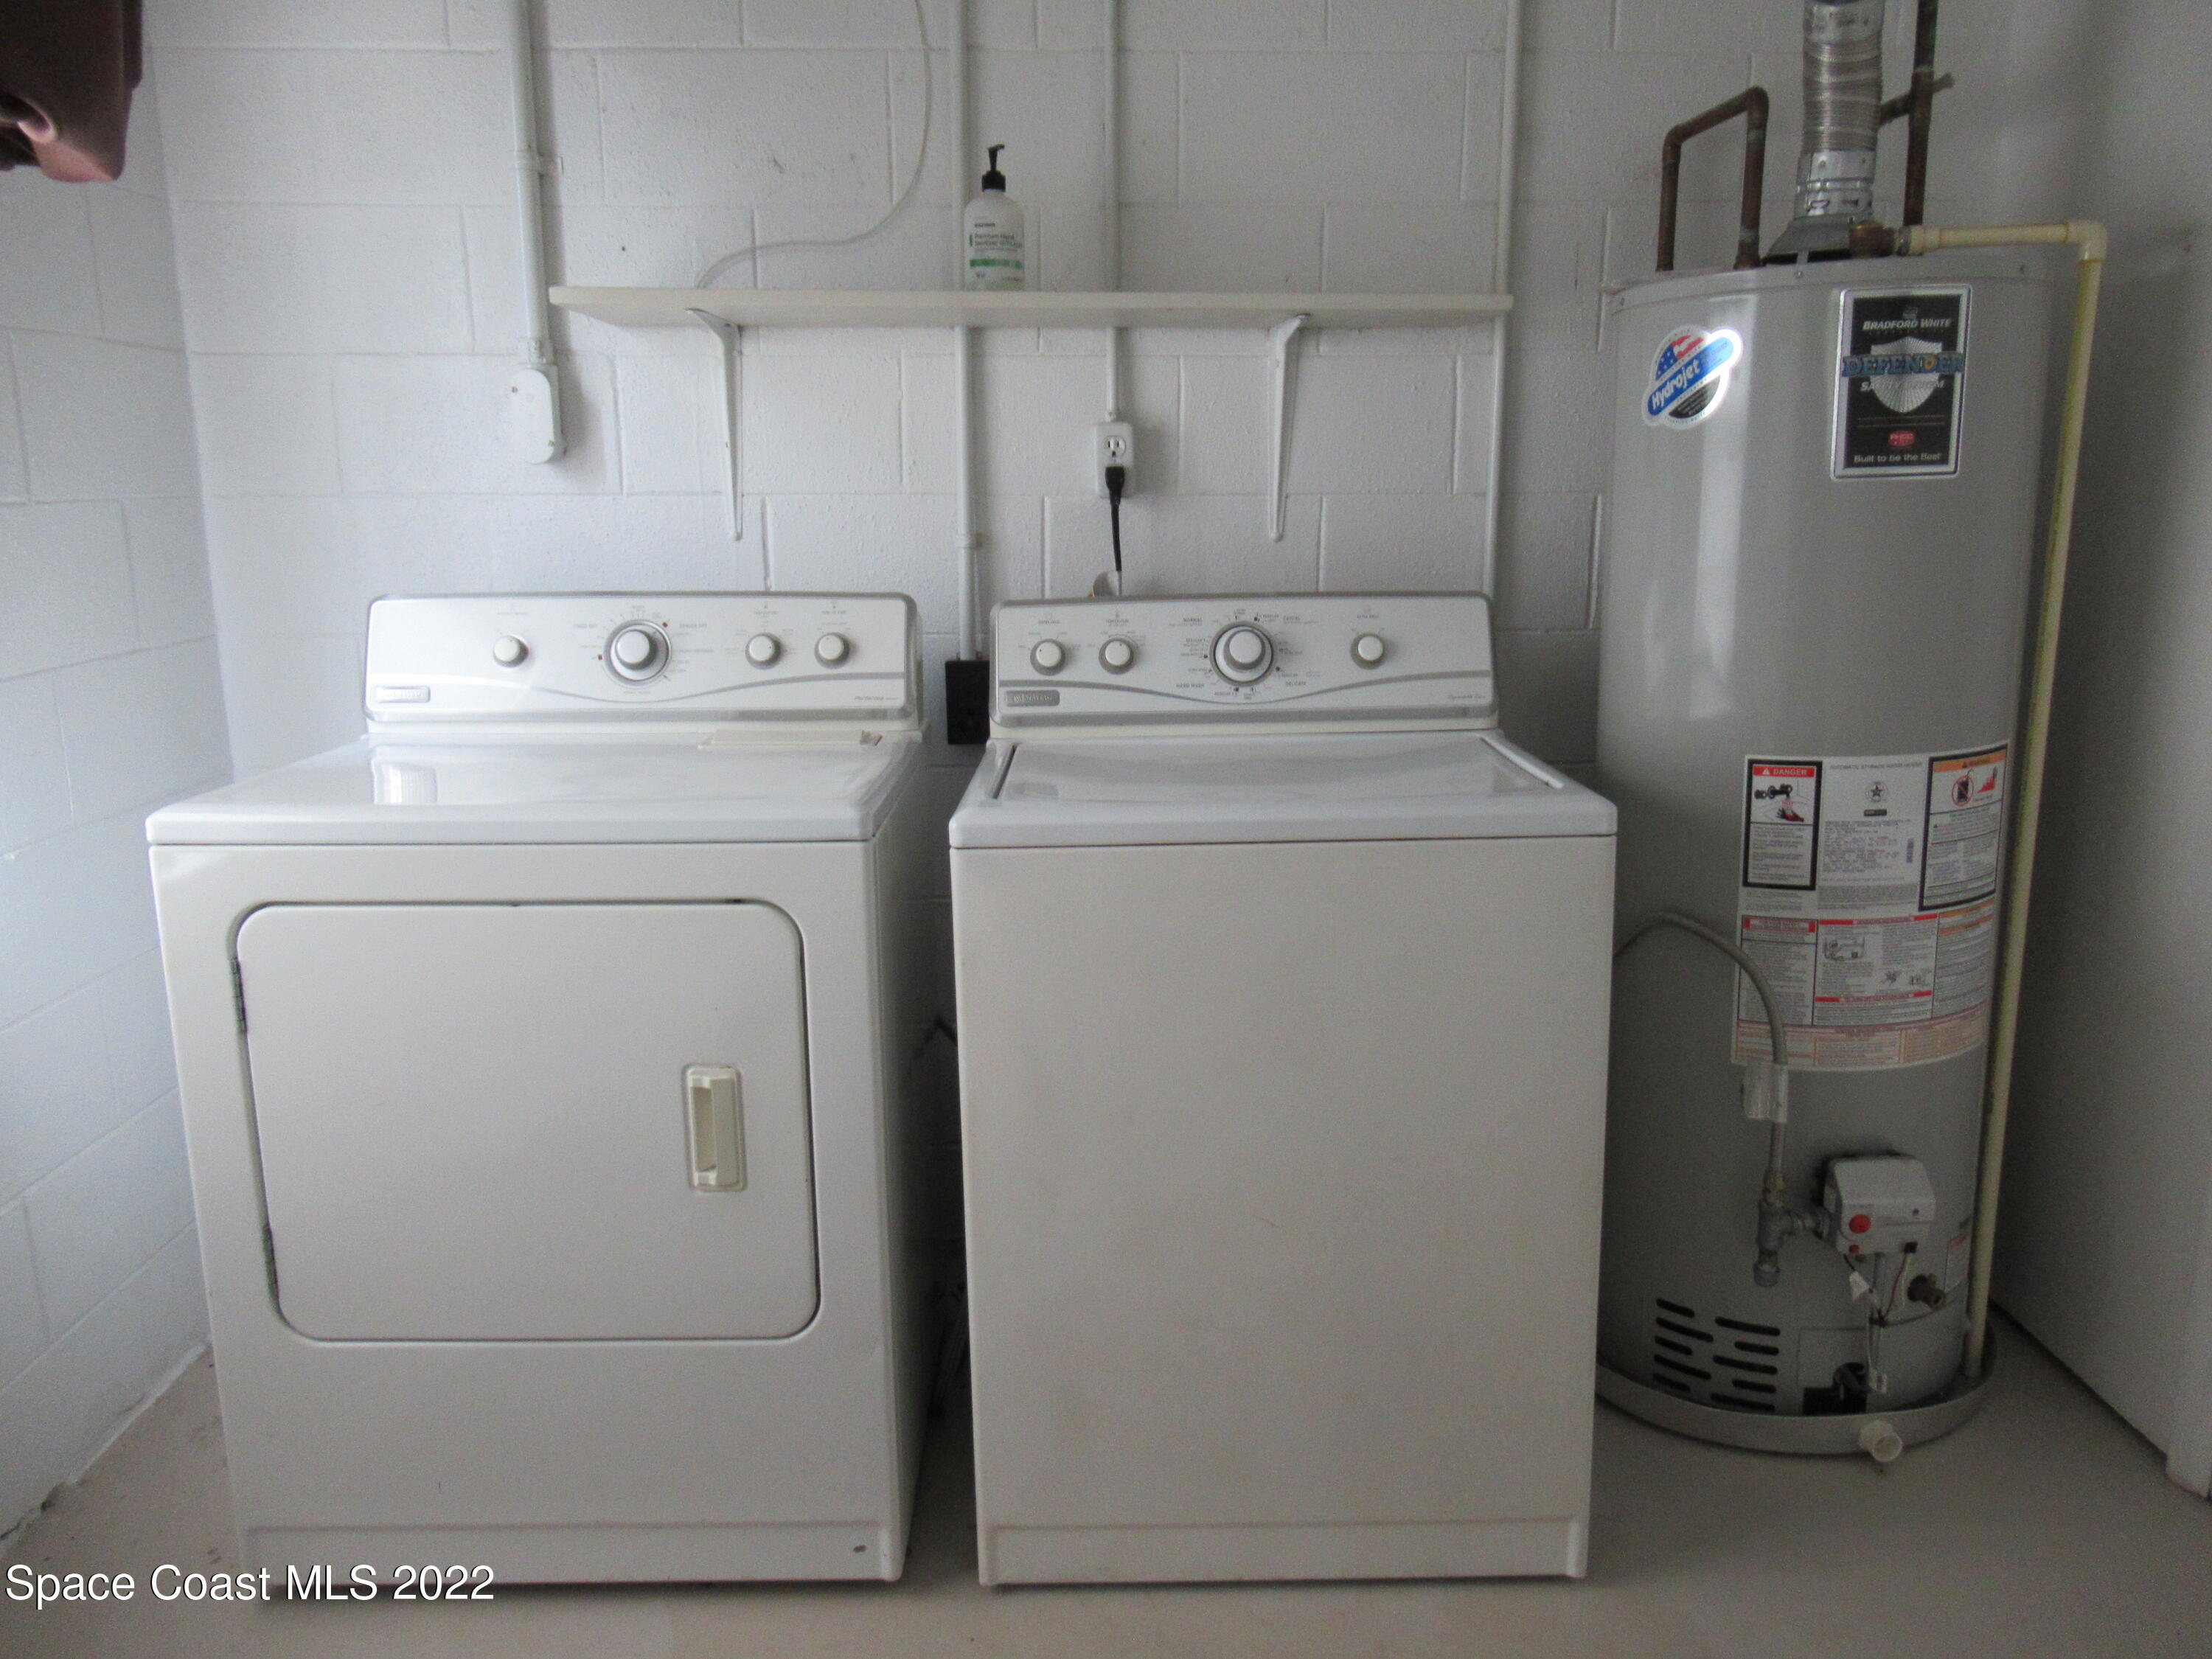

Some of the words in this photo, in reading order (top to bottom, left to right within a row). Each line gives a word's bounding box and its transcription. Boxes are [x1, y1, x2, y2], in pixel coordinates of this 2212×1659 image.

[1863, 319, 1918, 330] BRADFORD
[1920, 318, 1953, 328] WHITE
[1843, 352, 1965, 376] DEFENDER
[1652, 358, 1700, 410] Hydrojet
[1773, 768, 1808, 776] DANGER
